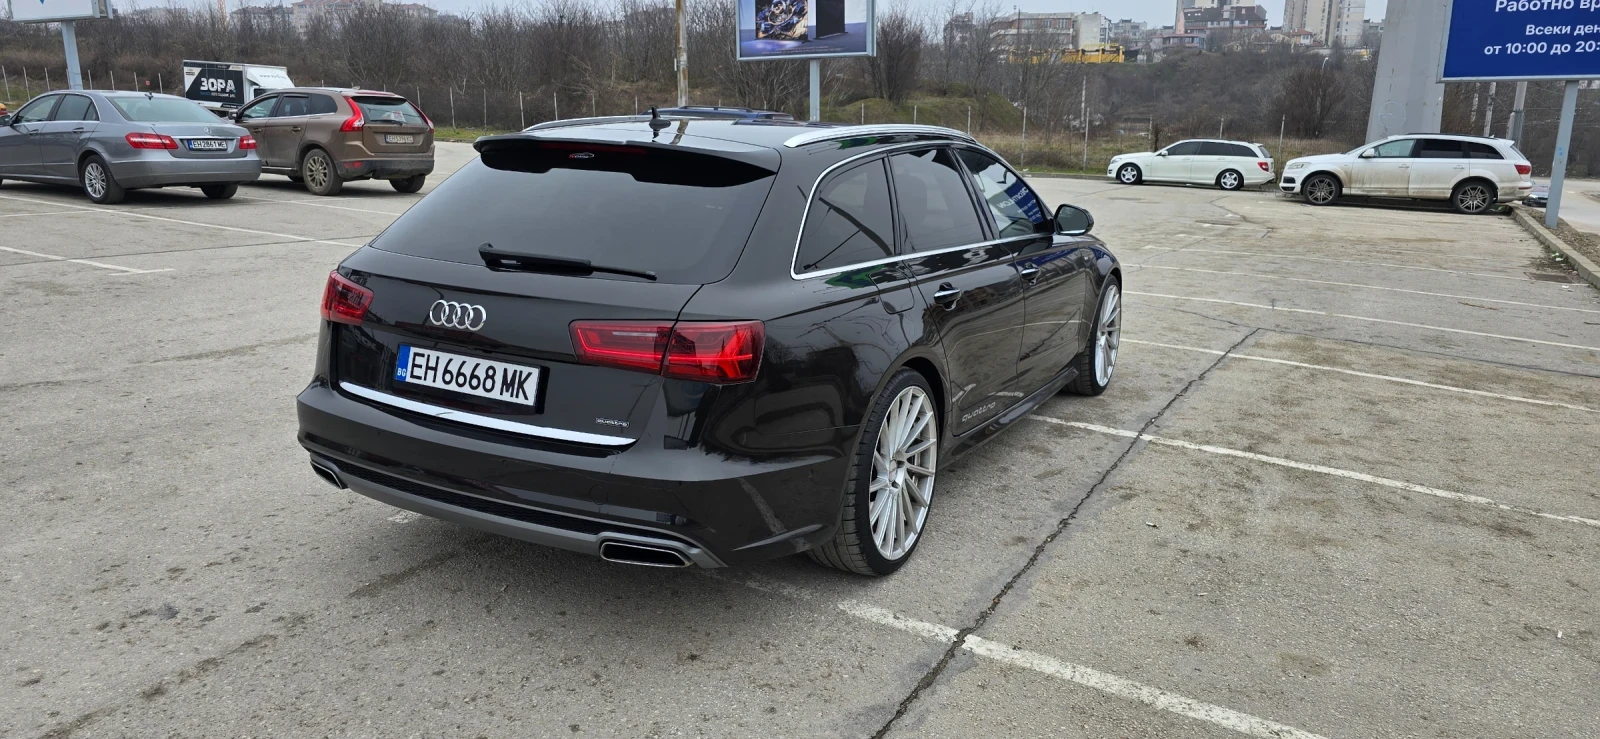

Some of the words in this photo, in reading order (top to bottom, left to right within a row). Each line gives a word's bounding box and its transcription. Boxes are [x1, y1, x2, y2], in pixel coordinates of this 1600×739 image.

[1495, 0, 1574, 12] Работно
[1526, 24, 1571, 35] Всеки
[1484, 45, 1501, 55] от
[1506, 42, 1547, 55] 10:00
[1550, 44, 1571, 55] до
[200, 77, 236, 93] ЗОРА
[397, 368, 407, 377] BG
[410, 352, 440, 383] EH
[442, 358, 497, 393] 6668
[500, 367, 533, 400] MK
[962, 402, 996, 422] quattro
